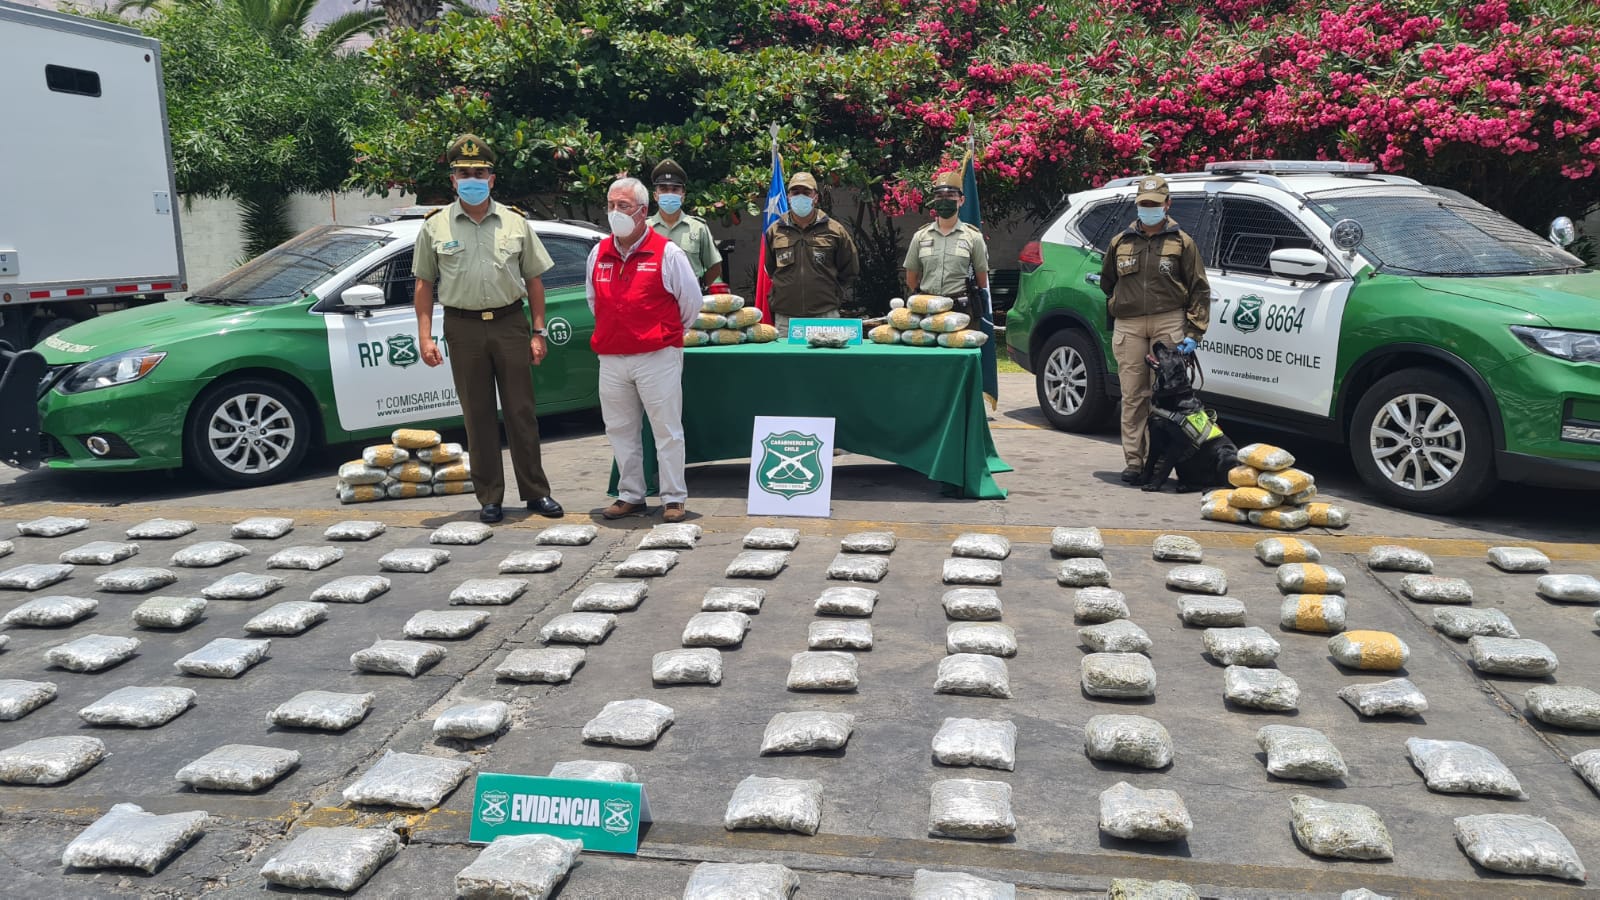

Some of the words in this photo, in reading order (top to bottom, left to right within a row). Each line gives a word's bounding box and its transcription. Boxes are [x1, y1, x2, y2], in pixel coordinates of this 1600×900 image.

[1219, 299, 1230, 324] Z
[1265, 304, 1306, 334] 8664
[552, 330, 568, 341] 133
[358, 341, 383, 368] RP
[1195, 340, 1264, 360] ARABINEROS
[1266, 349, 1282, 363] DE
[1285, 352, 1321, 369] CHILE
[1210, 367, 1279, 384] www.carabineros.cl
[386, 390, 439, 409] COMISARIA
[511, 793, 601, 828] EVIDENCIA
